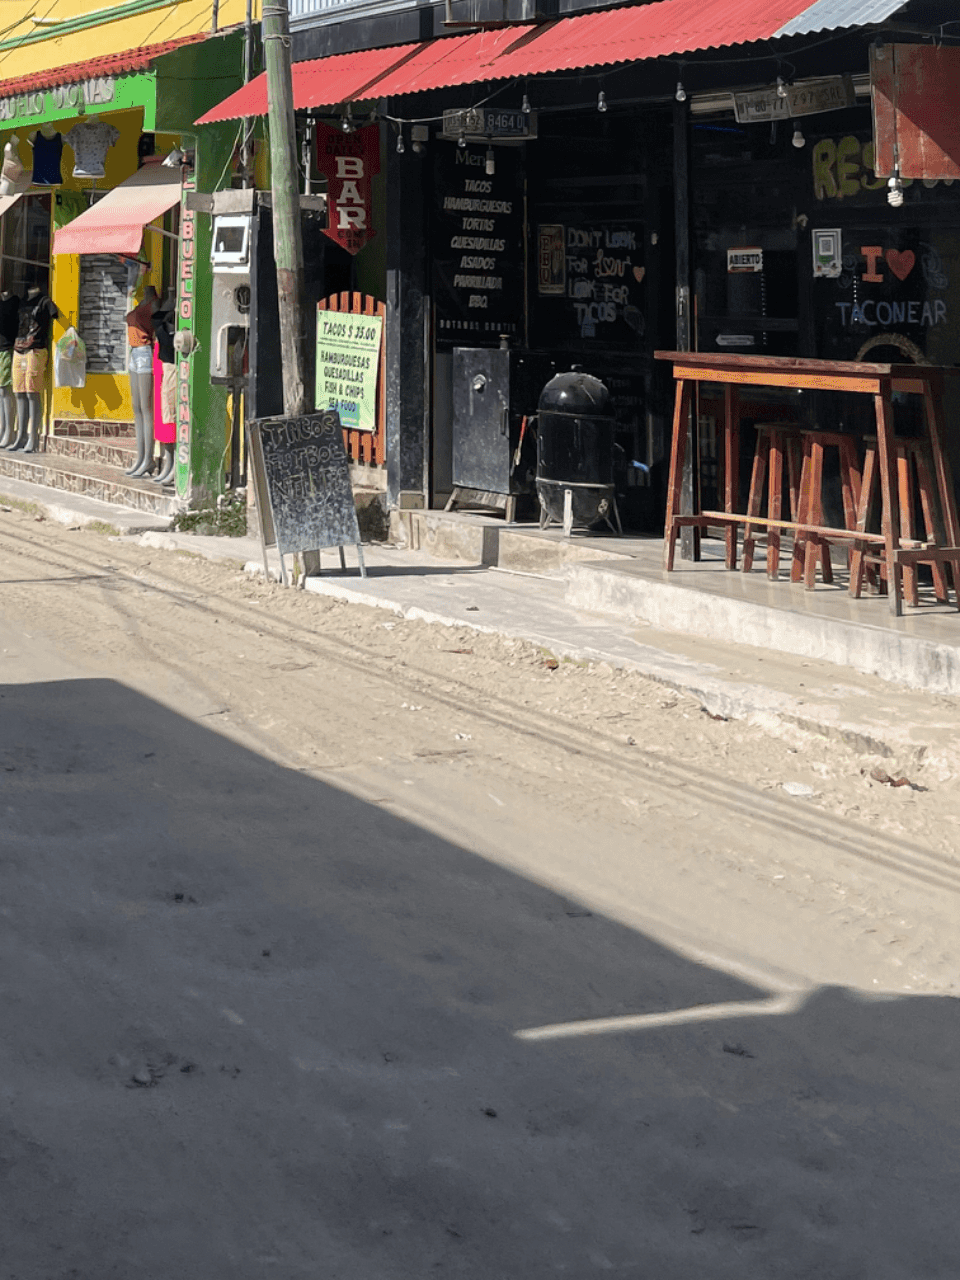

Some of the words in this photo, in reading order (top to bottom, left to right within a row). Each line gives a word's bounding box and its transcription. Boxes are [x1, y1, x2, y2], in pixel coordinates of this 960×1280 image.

[327, 133, 361, 145] OPEN
[455, 149, 486, 167] Men
[335, 156, 367, 230] BAR
[464, 179, 493, 194] TACOS
[443, 196, 513, 215] HAMBURGUESAS
[461, 217, 496, 232] TORTAS
[450, 235, 506, 252] QUESADILLAS
[567, 227, 602, 248] DON'T
[605, 229, 636, 251] LOOK
[459, 255, 496, 270] ASADOS
[729, 254, 760, 265] ABIERTO
[860, 245, 884, 283] I
[453, 273, 503, 290] PARRILLADA
[468, 294, 489, 309] BBQ
[603, 283, 629, 305] FOR
[573, 302, 616, 325] TACOS
[834, 299, 947, 327] TACONEAR
[324, 321, 346, 337] TACOS
[320, 349, 370, 369] HAMBURGUESAS
[323, 366, 364, 383] QUESADILLAS
[324, 380, 337, 395] FISH
[345, 384, 364, 400] CHIPS
[262, 414, 335, 449] TACOS
